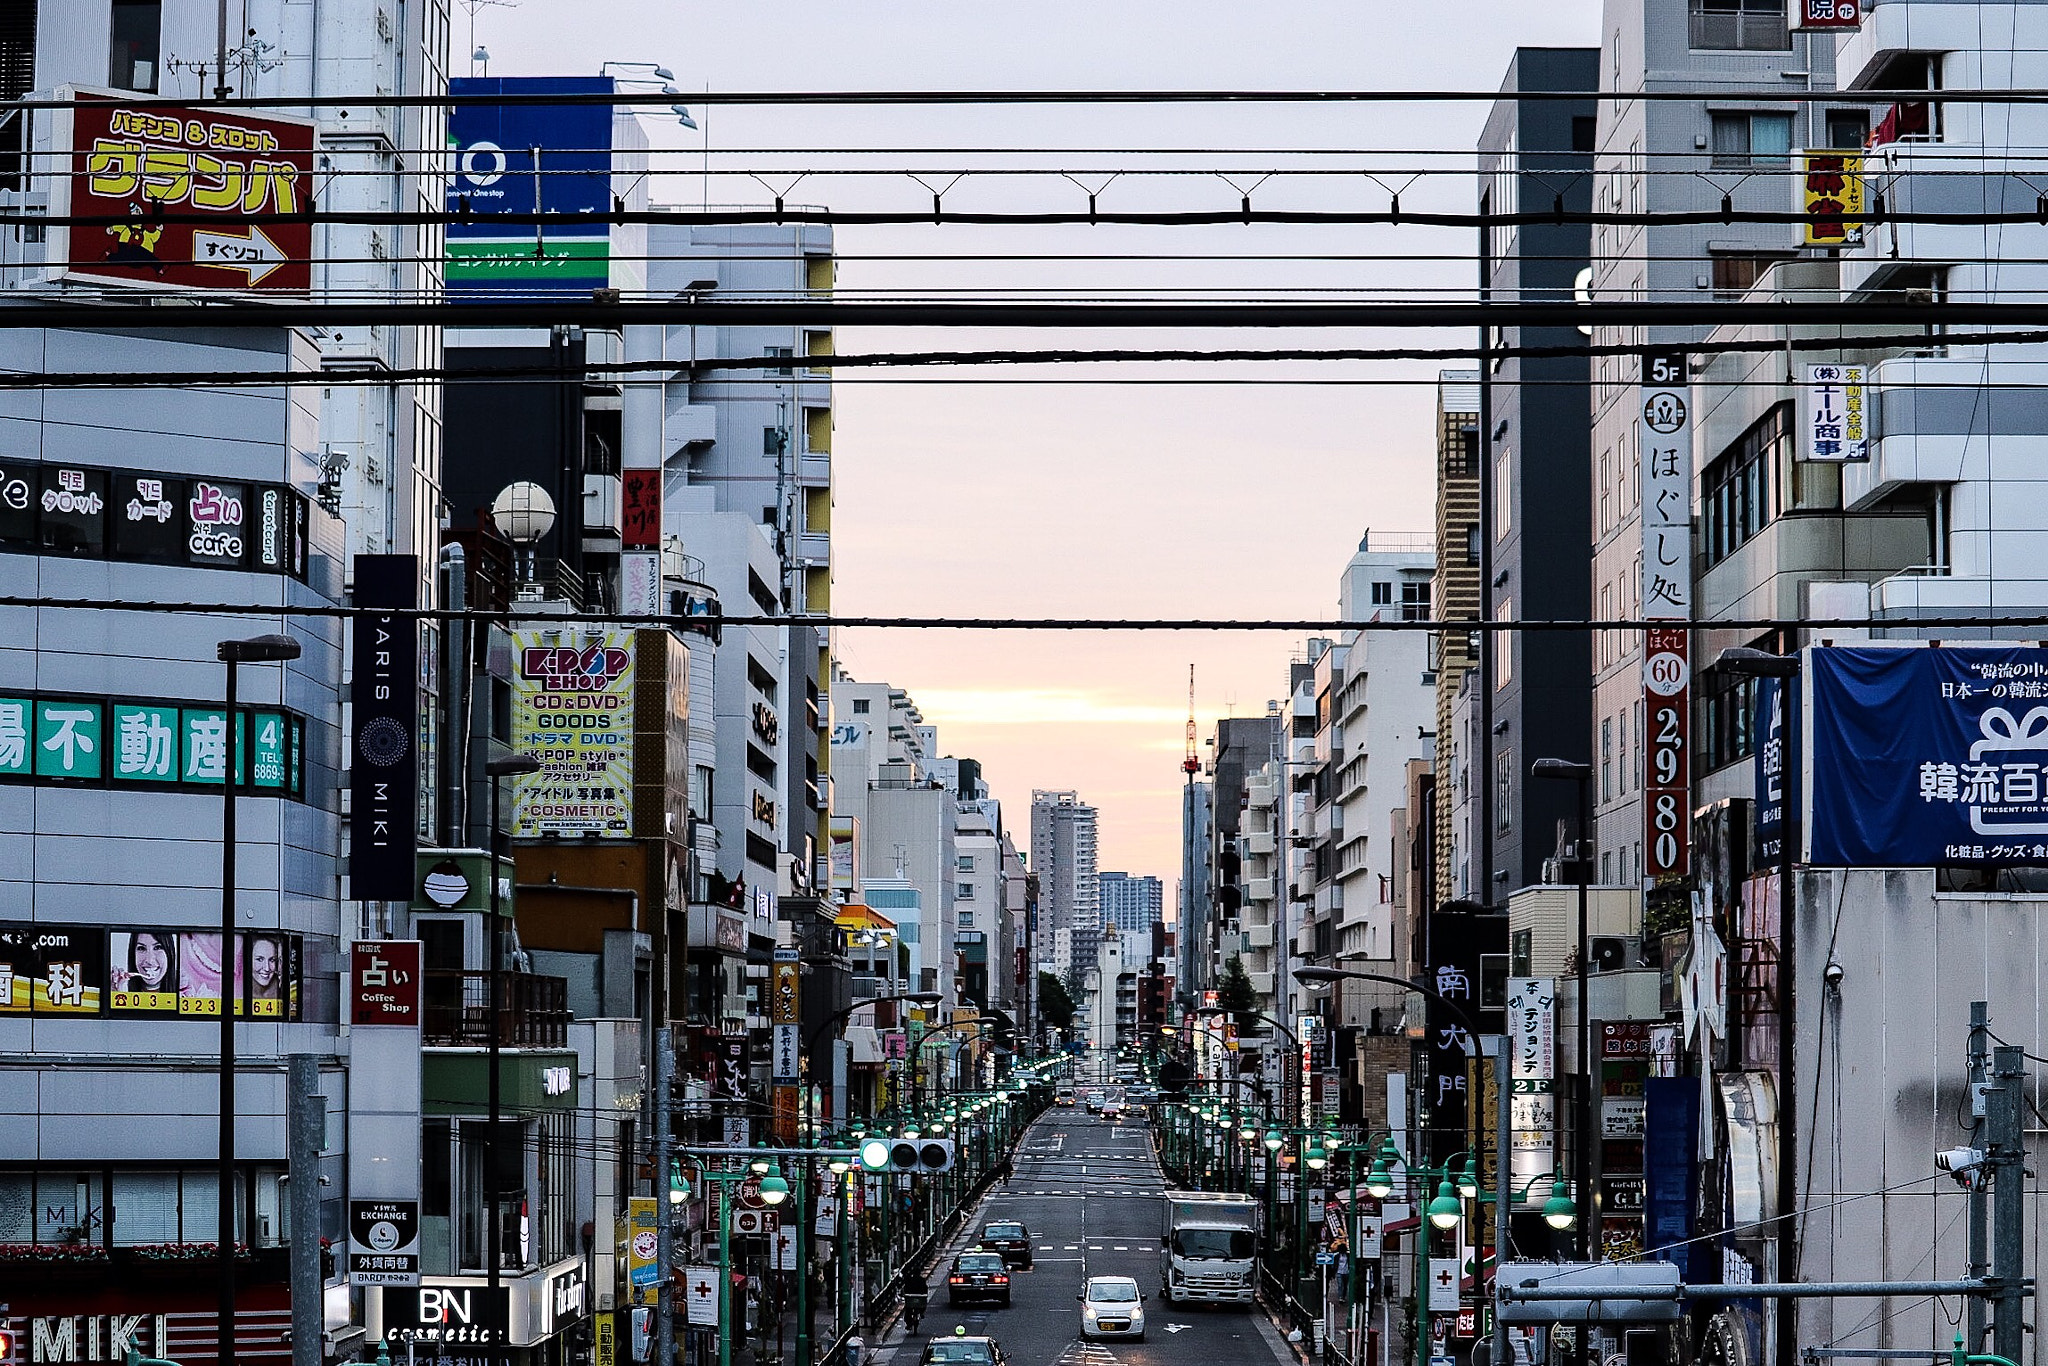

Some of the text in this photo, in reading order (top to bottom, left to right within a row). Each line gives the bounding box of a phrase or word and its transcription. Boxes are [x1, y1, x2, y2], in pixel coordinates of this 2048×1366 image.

[111, 110, 278, 154] パチンコ & スロット
[87, 138, 298, 214] グランパ
[1847, 228, 1861, 242] 6F
[206, 242, 264, 261] すぐソコ!
[1652, 358, 1679, 382] 5F
[1846, 369, 1863, 440] 不動産全般
[1850, 443, 1865, 457] 5F
[59, 470, 84, 491] 타로
[137, 479, 162, 501] 카드
[42, 489, 103, 514] タロット
[190, 482, 242, 525] 占い
[127, 499, 173, 523] カード
[263, 490, 278, 565] tarotcard
[1648, 447, 1687, 606] ほぐし処
[189, 533, 242, 557] cafe
[1650, 635, 1684, 649] ほぐし
[524, 641, 631, 677] K-POP
[1652, 659, 1681, 683] 60
[1971, 662, 2048, 679] “韓流の中
[546, 674, 609, 690] SHOP
[538, 714, 611, 729] GOODS
[531, 732, 618, 745] ドラマ DVD
[260, 752, 279, 763] TEL
[530, 749, 617, 762] K-POP style
[543, 772, 602, 781] アクセサリー
[1920, 761, 2048, 803] 韓流百
[530, 787, 574, 800] アイドル
[374, 783, 388, 846] MIKI
[530, 805, 617, 817] COSMETIC
[1945, 844, 2048, 858] 化粧品・グッズ・食
[362, 956, 409, 987] 占い
[361, 993, 395, 1002] Coffee
[382, 1003, 410, 1014] Shop
[1436, 965, 1470, 1107] 南大門
[1616, 1025, 1650, 1036] ソウ
[1515, 1080, 1549, 1092] 2F
[46, 1206, 116, 1224] MIKI
[361, 1212, 407, 1220] EXCHANGE
[360, 1256, 408, 1269] 外貨両替
[1225, 1271, 1243, 1279] 025
[419, 1289, 471, 1324] BN
[1459, 1314, 1475, 1330] たば
[33, 1314, 167, 1363] MIKI
[388, 1324, 503, 1343] cosmetic
